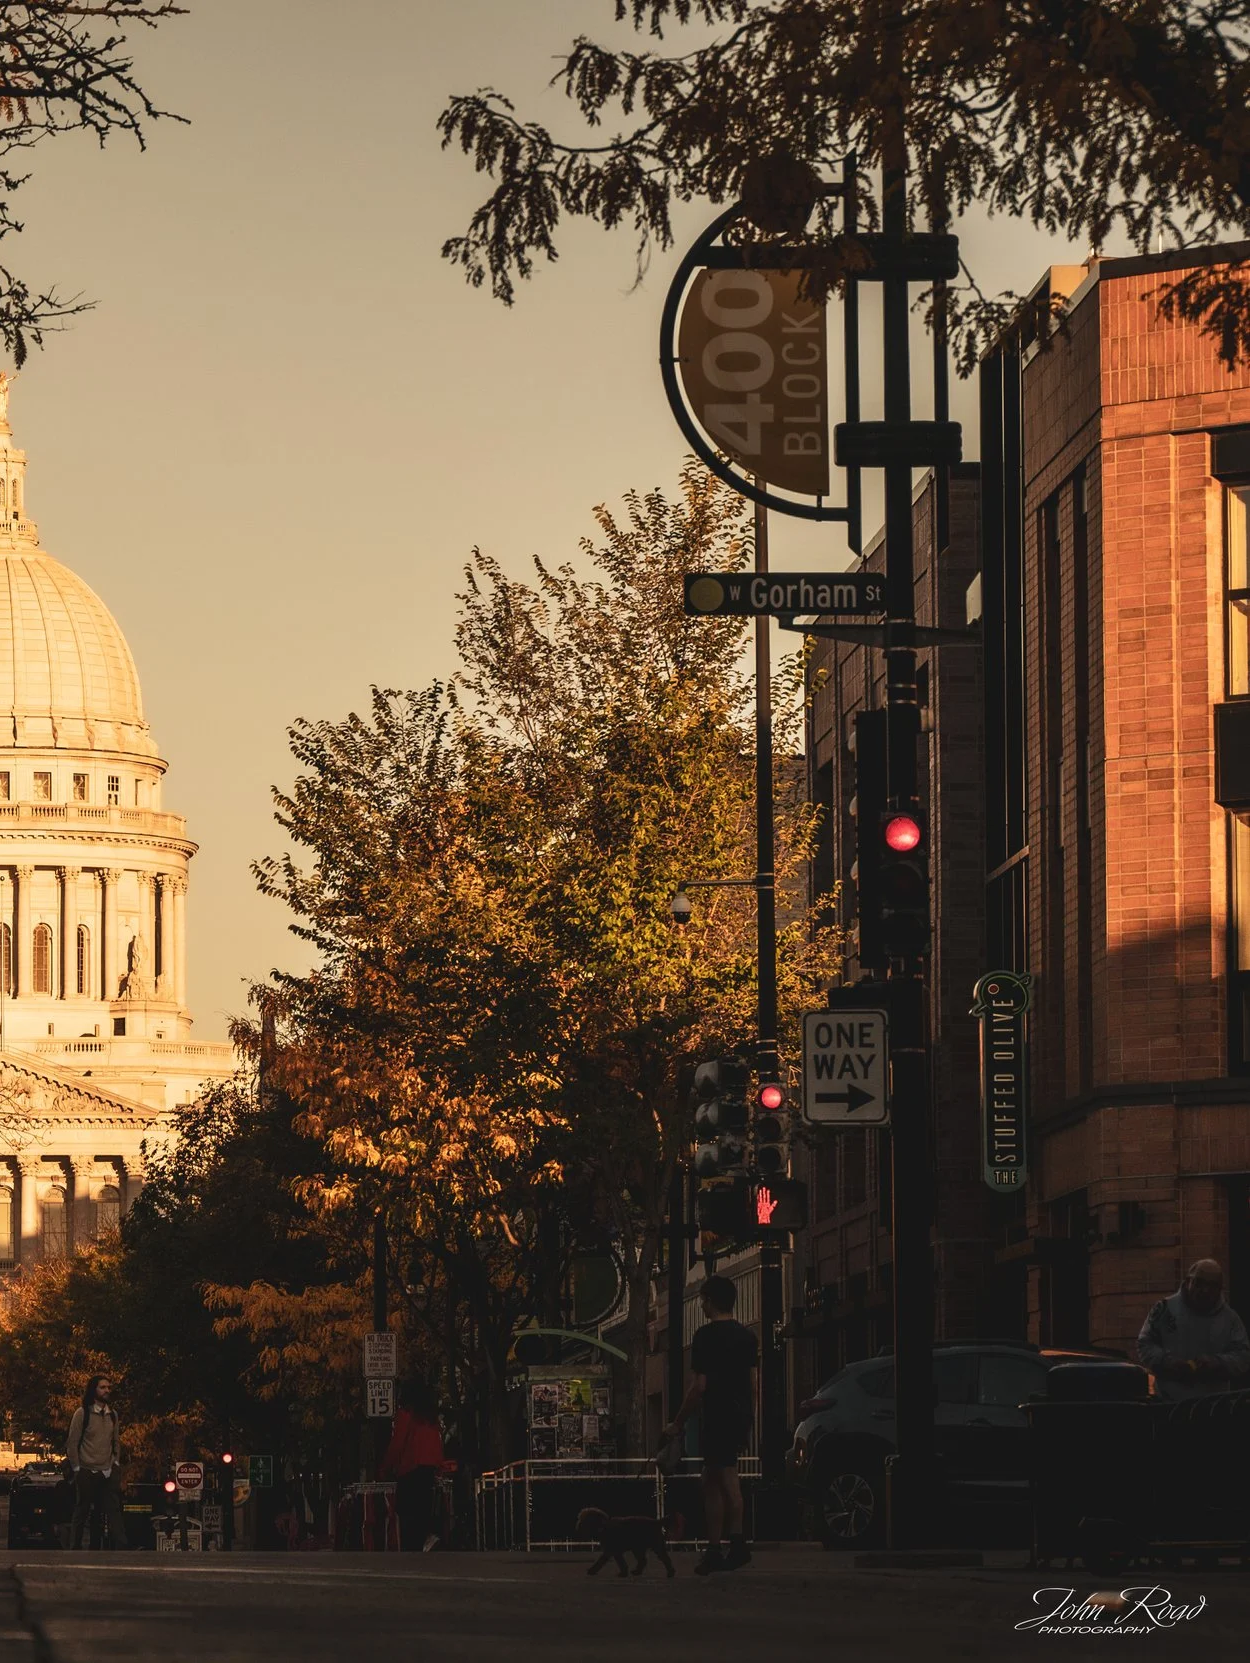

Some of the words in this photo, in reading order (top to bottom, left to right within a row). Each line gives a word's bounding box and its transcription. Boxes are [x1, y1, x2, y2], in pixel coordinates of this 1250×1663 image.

[700, 269, 775, 456] 400
[781, 311, 822, 456] BLOCK
[729, 584, 741, 601] W
[750, 577, 857, 609] Gorham
[866, 585, 882, 602] St
[815, 1022, 875, 1049] ONE
[992, 999, 1015, 1061] OLIVE
[813, 1054, 876, 1080] WAY
[993, 1073, 1017, 1162] STUFFED
[994, 1170, 1018, 1185] THE
[366, 1334, 375, 1342] NO
[376, 1334, 394, 1342] TRUCK
[368, 1381, 392, 1390] SPEED
[370, 1389, 389, 1397] LIMIT
[370, 1398, 389, 1414] 15
